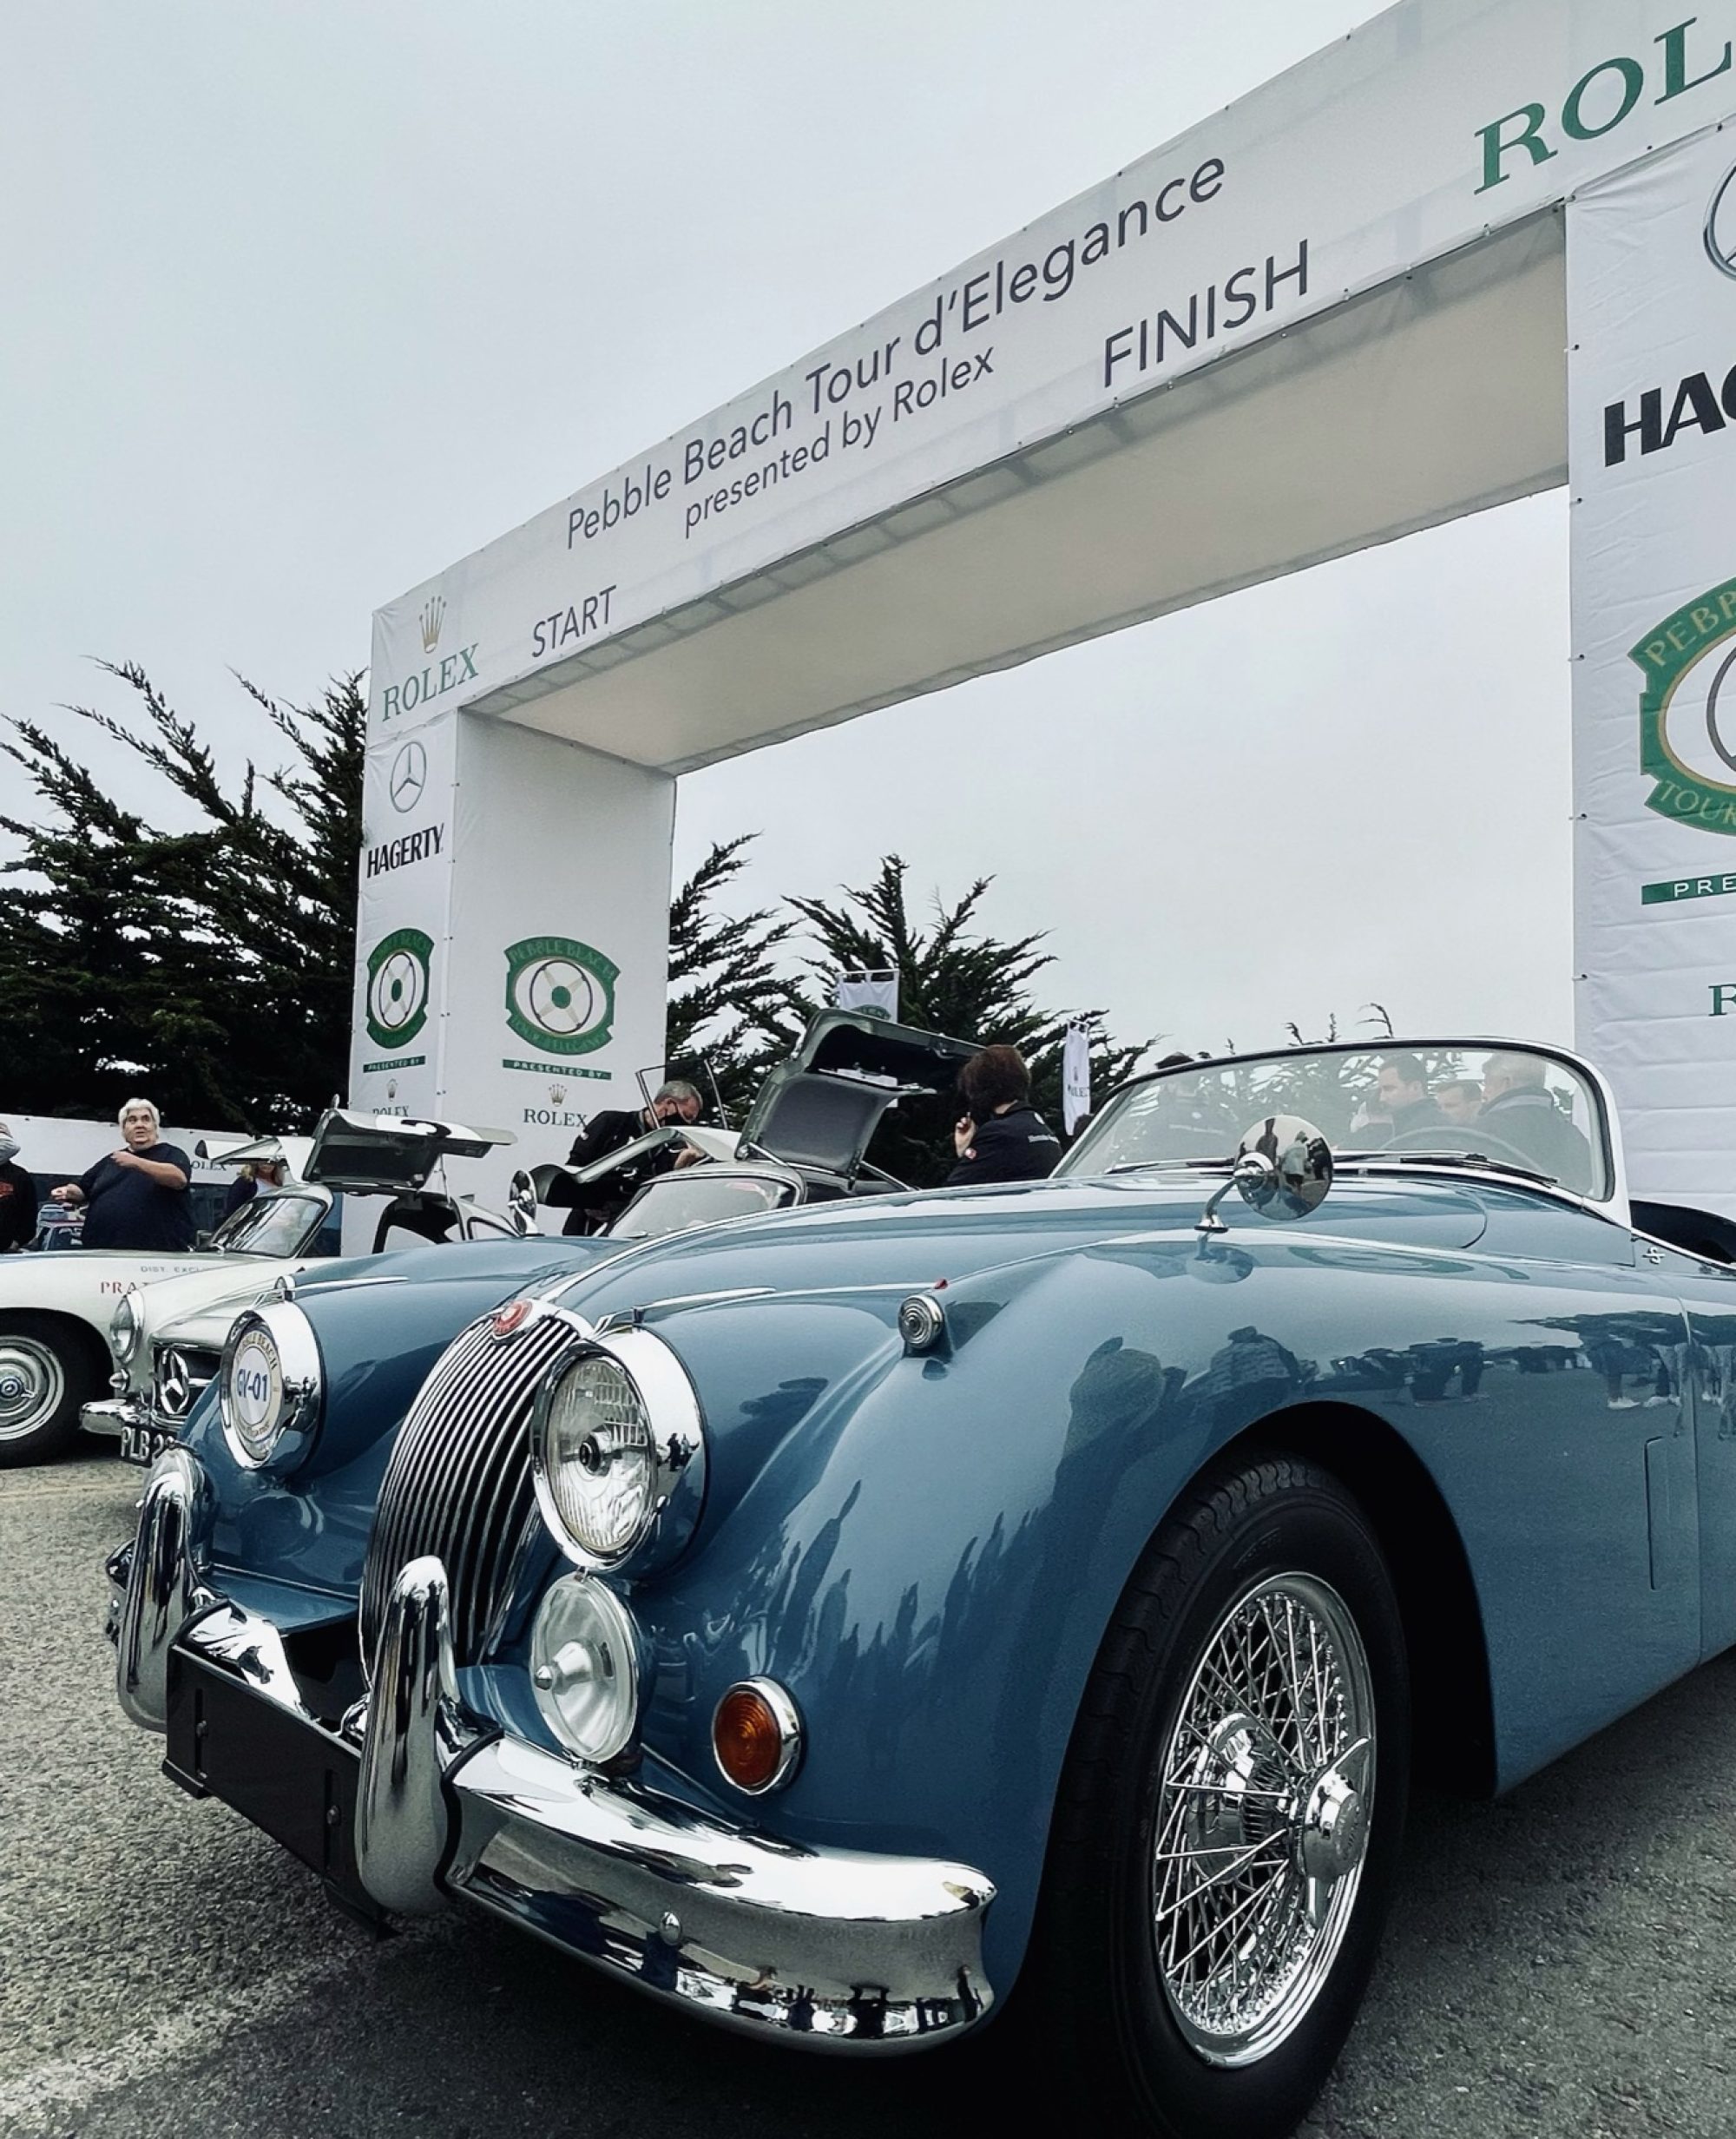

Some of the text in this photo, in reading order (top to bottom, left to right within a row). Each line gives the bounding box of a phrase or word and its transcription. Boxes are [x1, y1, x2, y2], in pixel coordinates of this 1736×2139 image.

[1104, 240, 1309, 388] FINISH
[567, 464, 672, 550] Pebble
[684, 391, 792, 485] Beach
[806, 336, 900, 414] Tour
[685, 347, 994, 538] presented by Rolex
[531, 585, 617, 658] START
[382, 642, 479, 722] ROLEX
[367, 822, 444, 879] HAGERTY
[513, 1062, 602, 1080] PRESENTED BY
[523, 1109, 589, 1127] ROLEX
[120, 1426, 150, 1461] PLB
